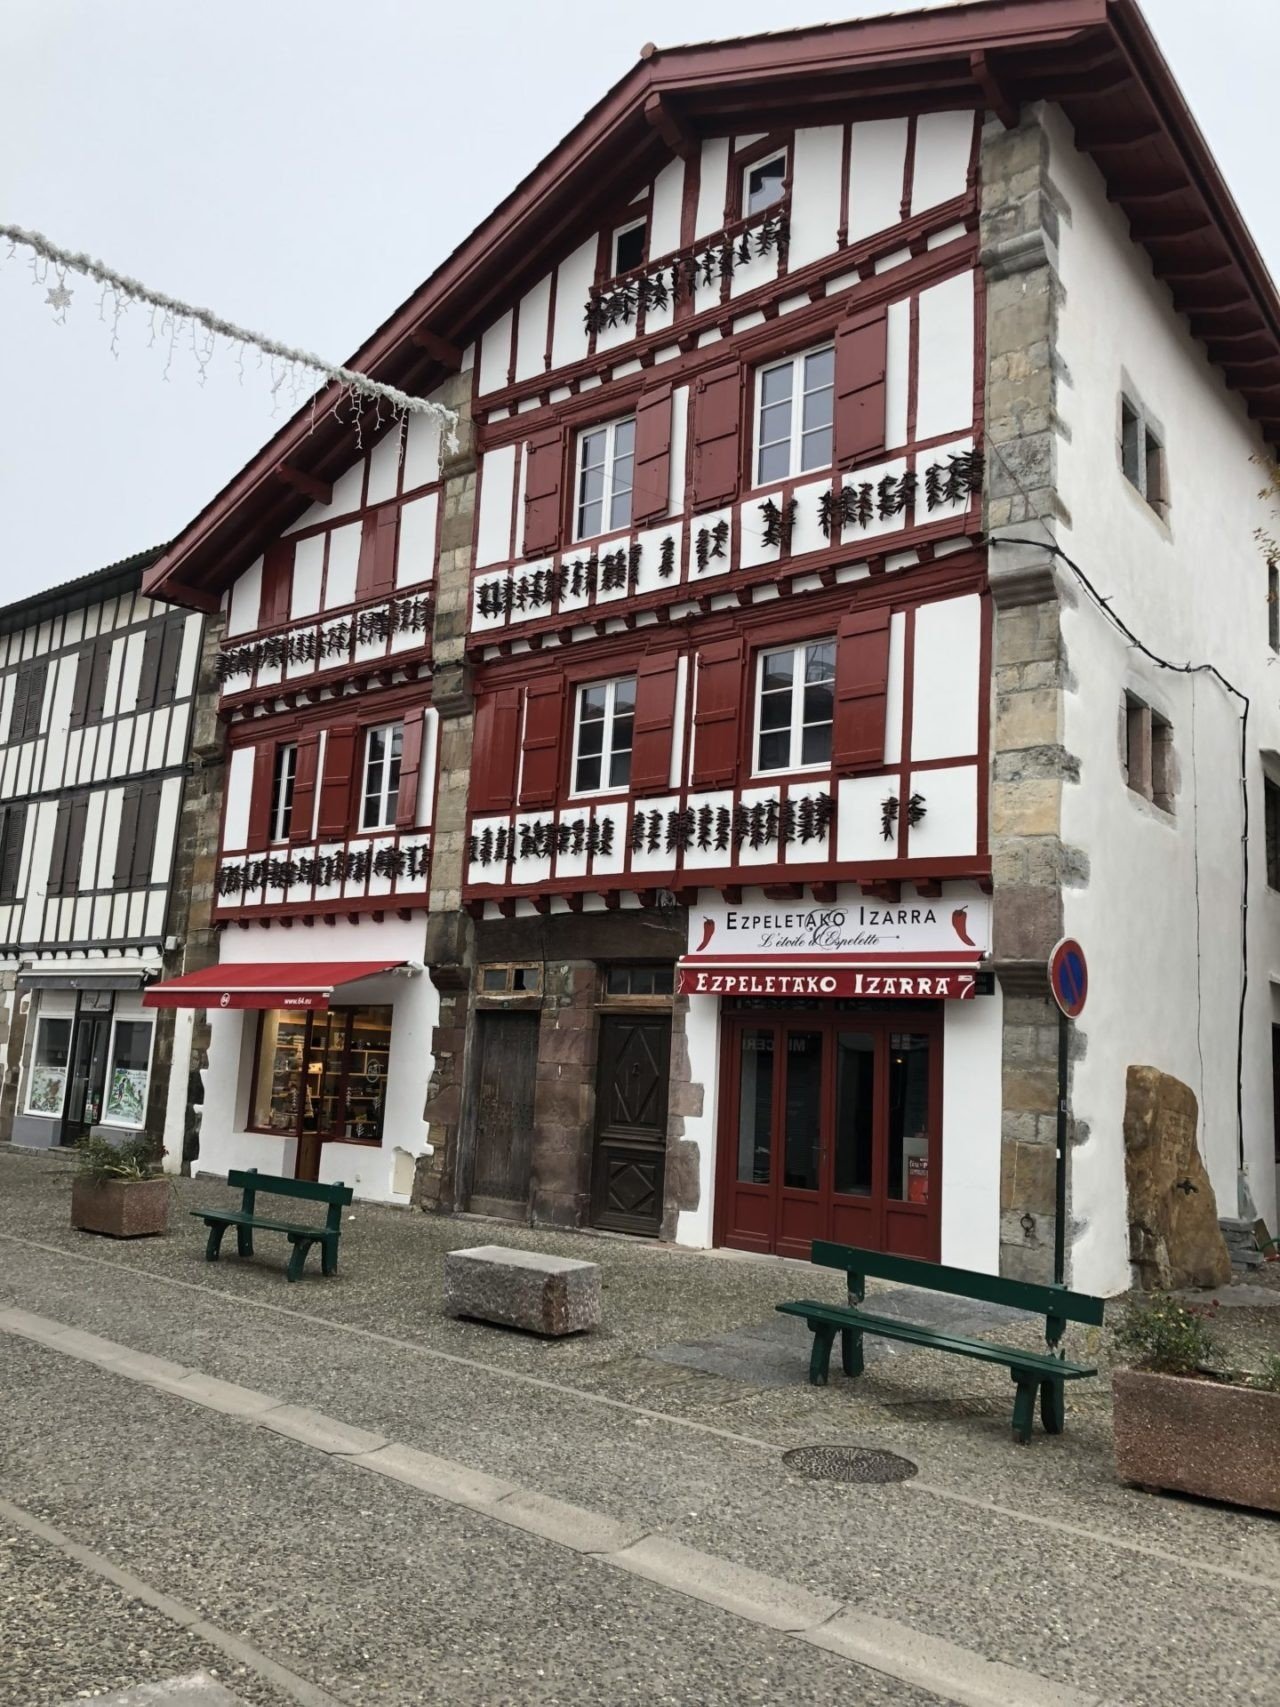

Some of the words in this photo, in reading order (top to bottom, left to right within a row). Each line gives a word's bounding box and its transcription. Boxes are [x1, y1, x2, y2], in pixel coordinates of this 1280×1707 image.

[726, 911, 845, 930] EZPELETAKO
[860, 906, 936, 925] IZARRA
[758, 932, 806, 948] L'étoile
[696, 973, 837, 993] EZPELETAKO
[854, 974, 950, 994] IZARRA
